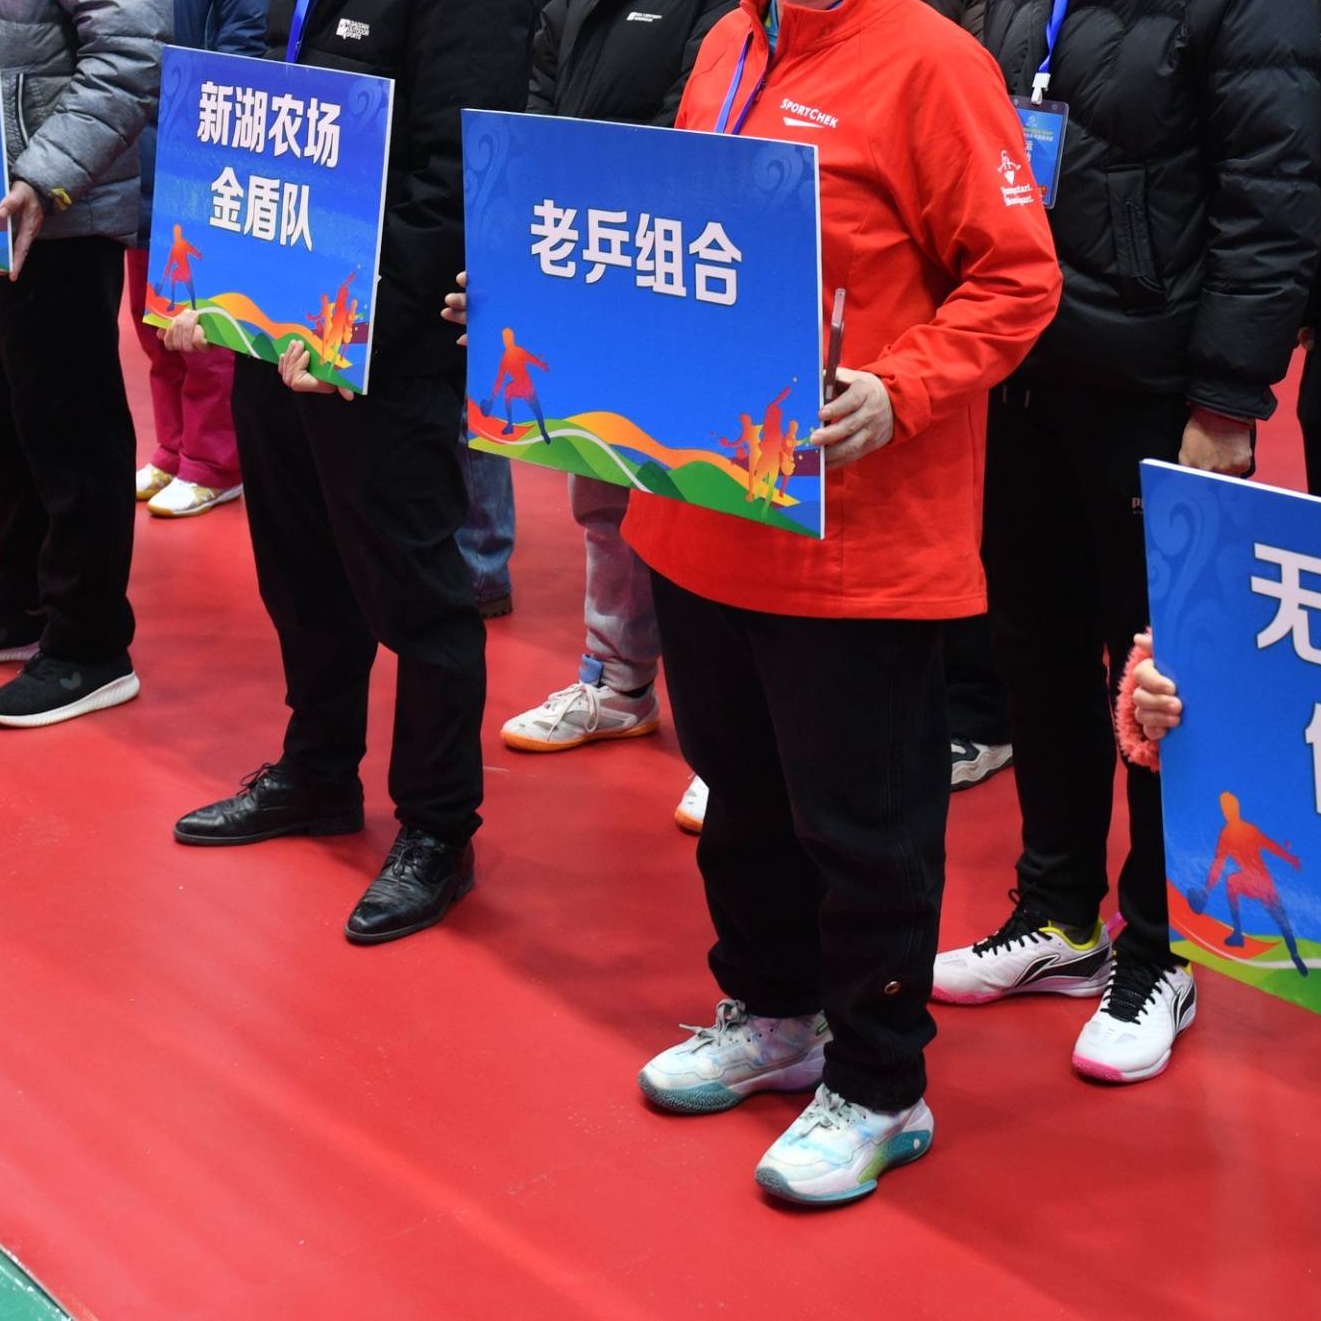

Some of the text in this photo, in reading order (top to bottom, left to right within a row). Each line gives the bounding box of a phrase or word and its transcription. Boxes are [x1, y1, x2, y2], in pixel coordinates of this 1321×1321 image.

[196, 80, 342, 169] 新湖农场
[209, 166, 314, 253] 金盾队
[529, 197, 743, 307] 老乒组合
